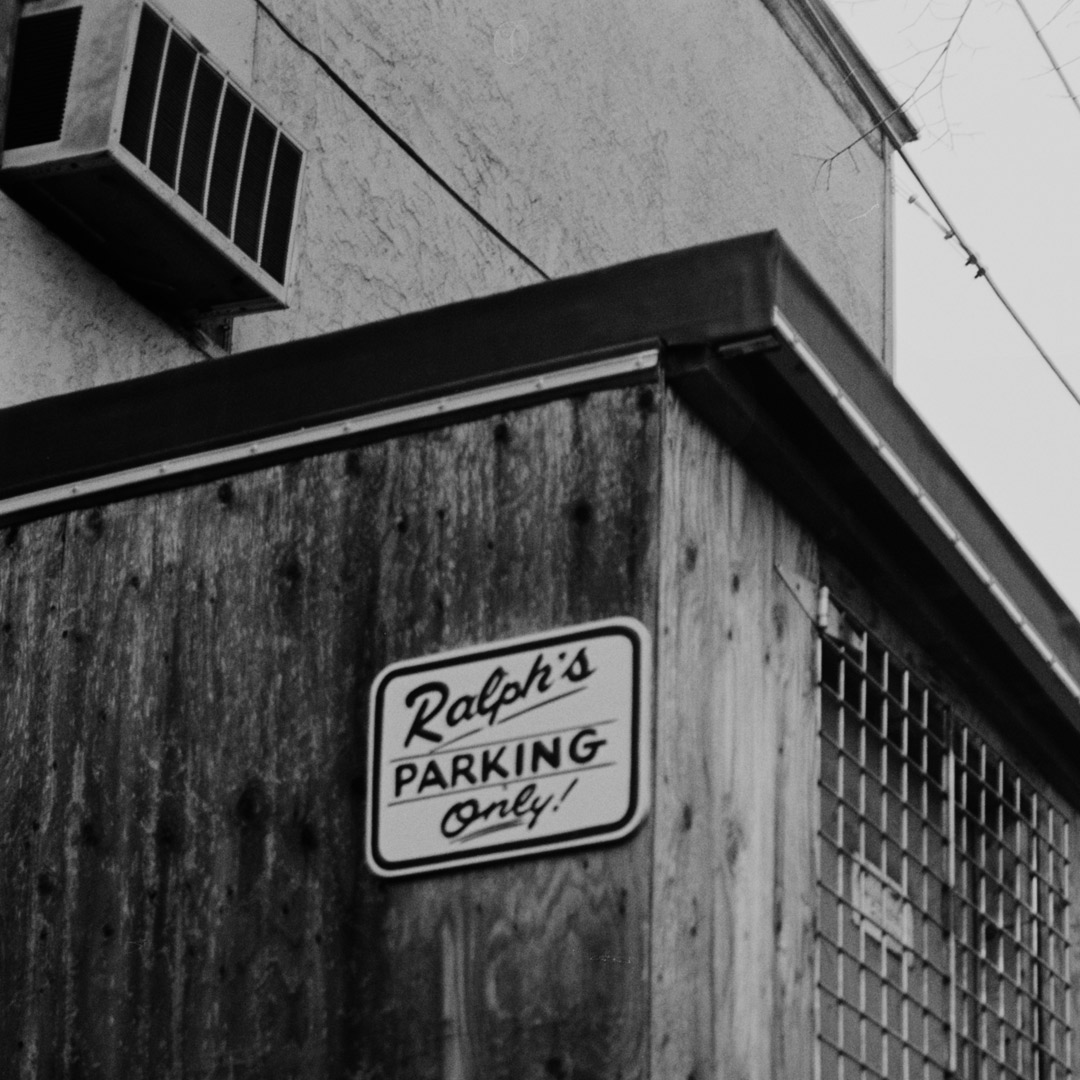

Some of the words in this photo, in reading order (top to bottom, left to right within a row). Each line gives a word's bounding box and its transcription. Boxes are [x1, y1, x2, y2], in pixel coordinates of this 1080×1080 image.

[404, 647, 597, 747] Ralph's
[395, 729, 607, 798] PARKING
[440, 777, 579, 839] Only!
